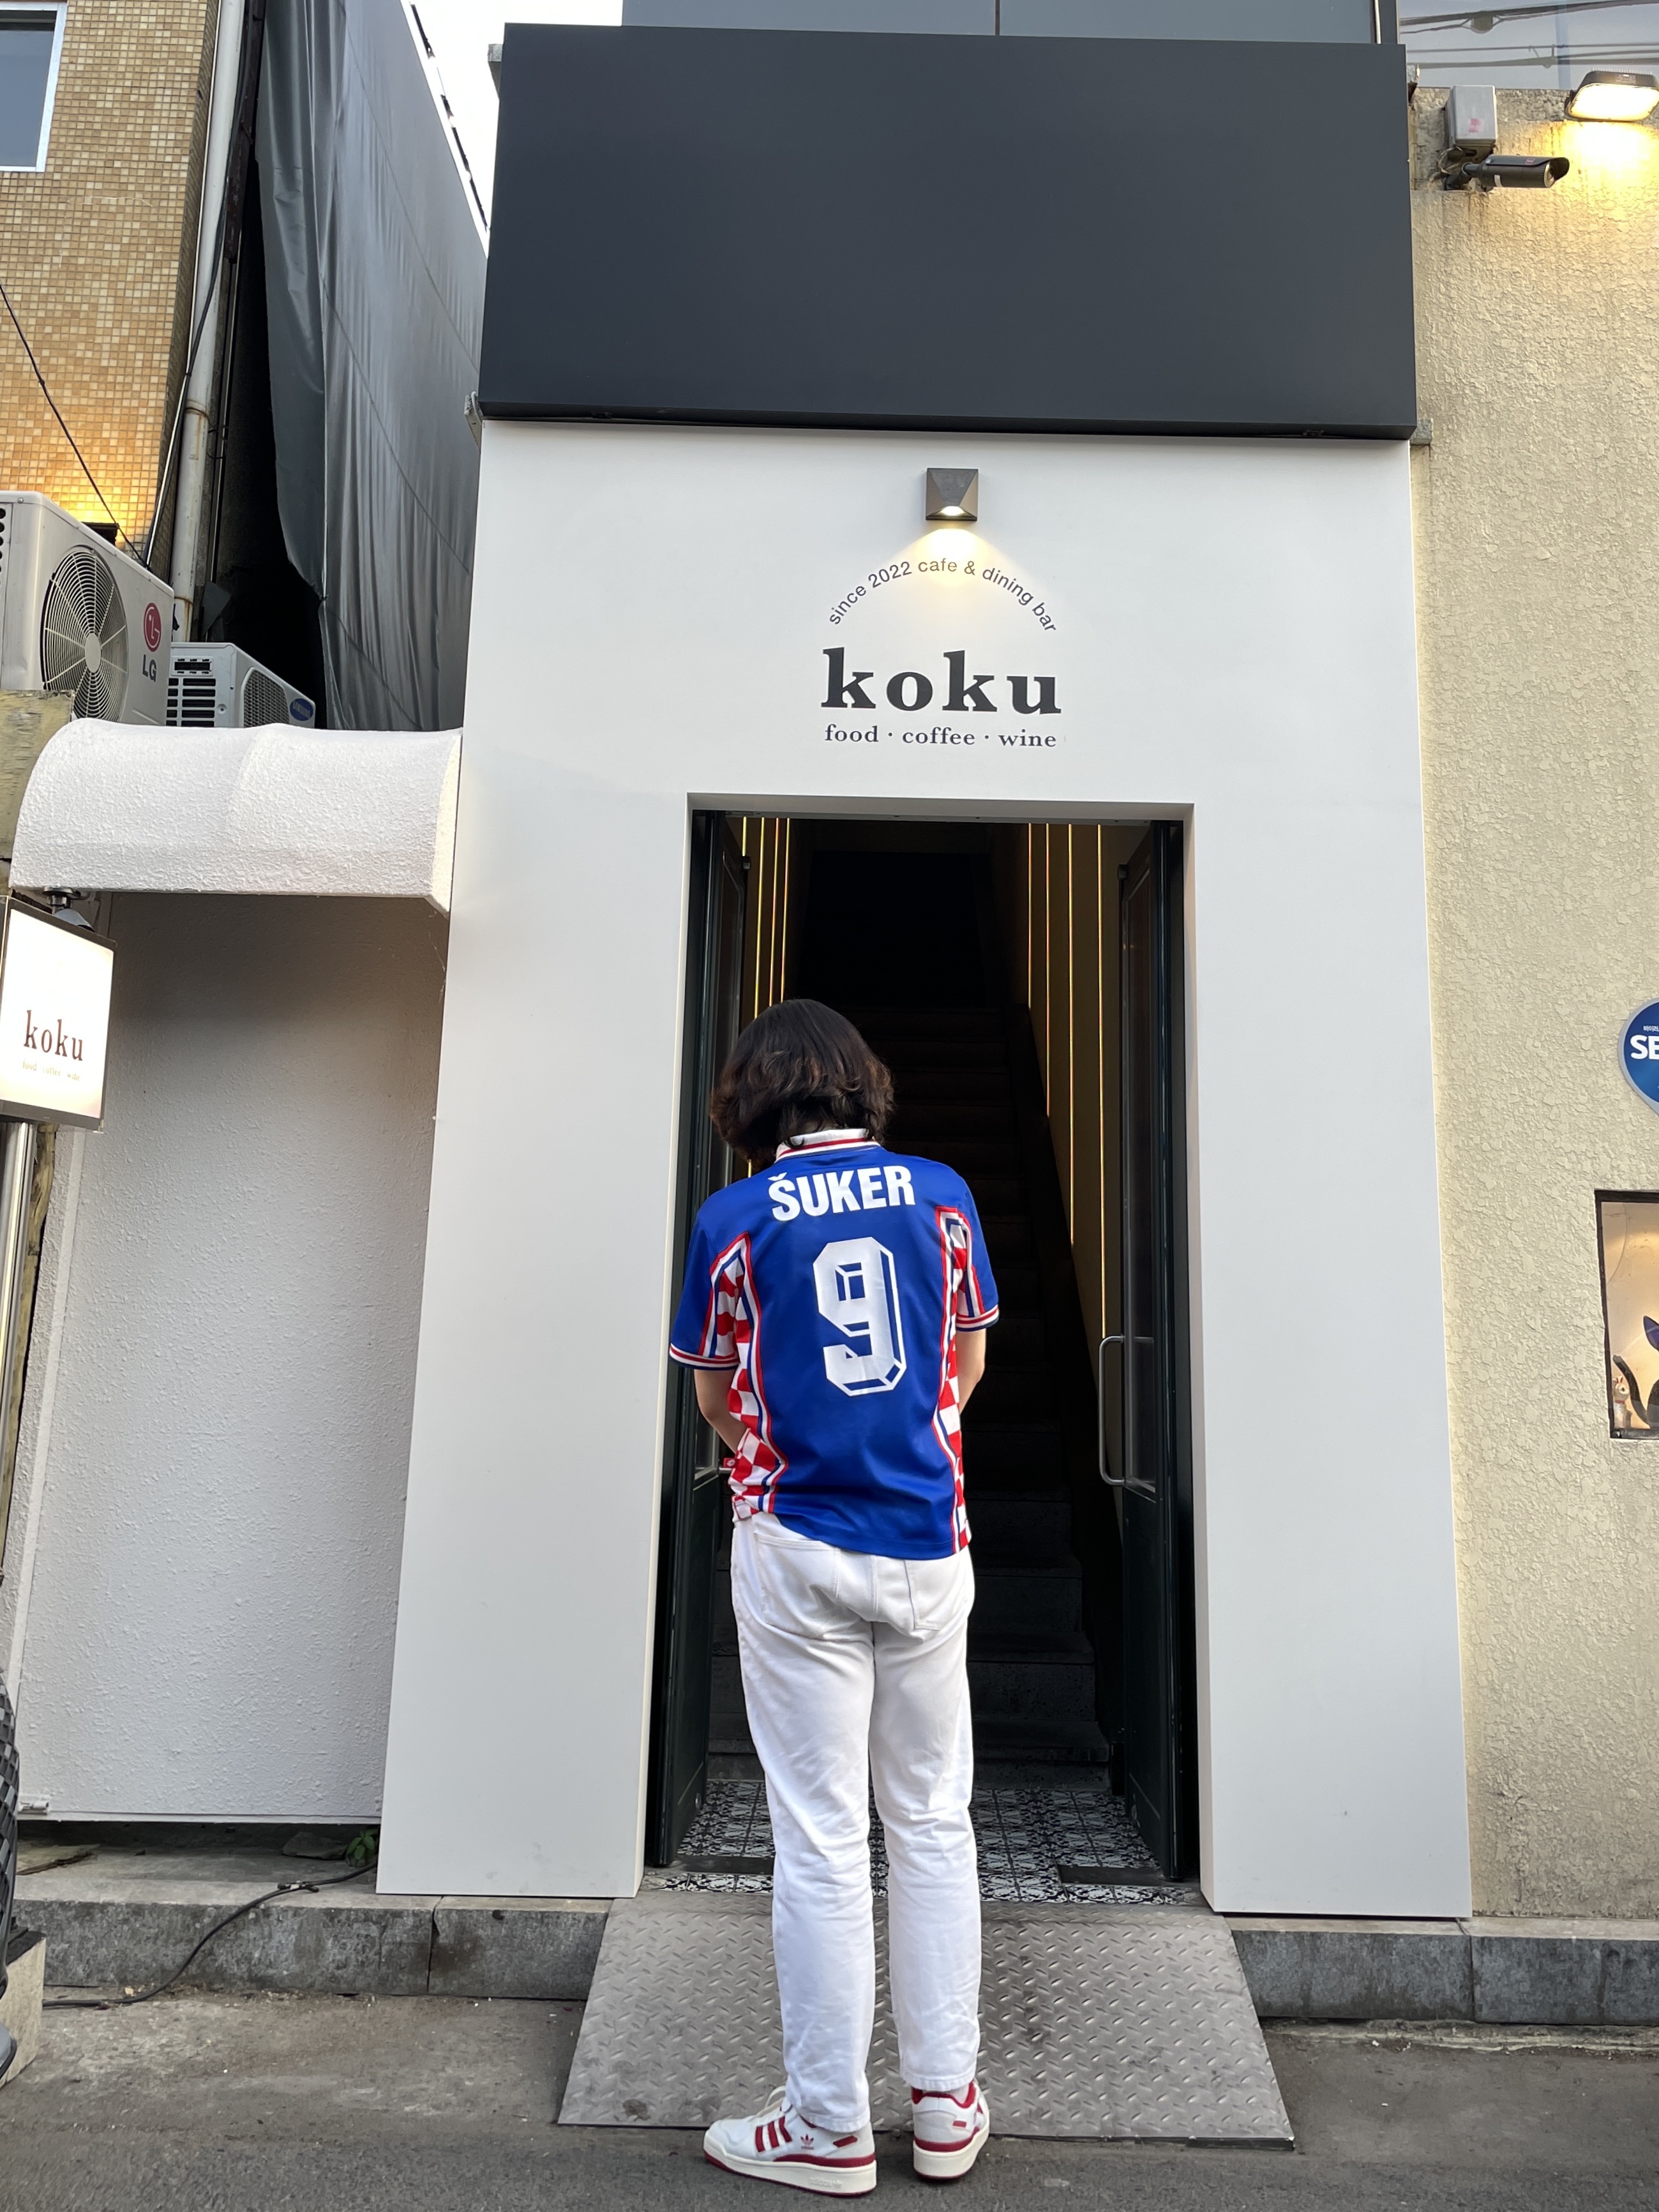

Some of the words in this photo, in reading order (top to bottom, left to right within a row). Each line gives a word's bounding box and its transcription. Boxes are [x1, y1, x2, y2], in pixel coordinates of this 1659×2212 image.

[829, 583, 867, 625] since
[867, 561, 913, 589] 2022
[918, 558, 957, 573] cafe
[964, 561, 976, 575] &
[982, 568, 1033, 606] dining
[1032, 602, 1057, 633] bar
[142, 654, 157, 682] LG
[821, 647, 1062, 714] koku
[824, 723, 879, 743] food
[901, 726, 975, 745] coffee
[998, 728, 1057, 748] wine
[23, 1009, 83, 1061] koku
[768, 1165, 916, 1222] ŠUKER
[812, 1236, 907, 1397] 9
